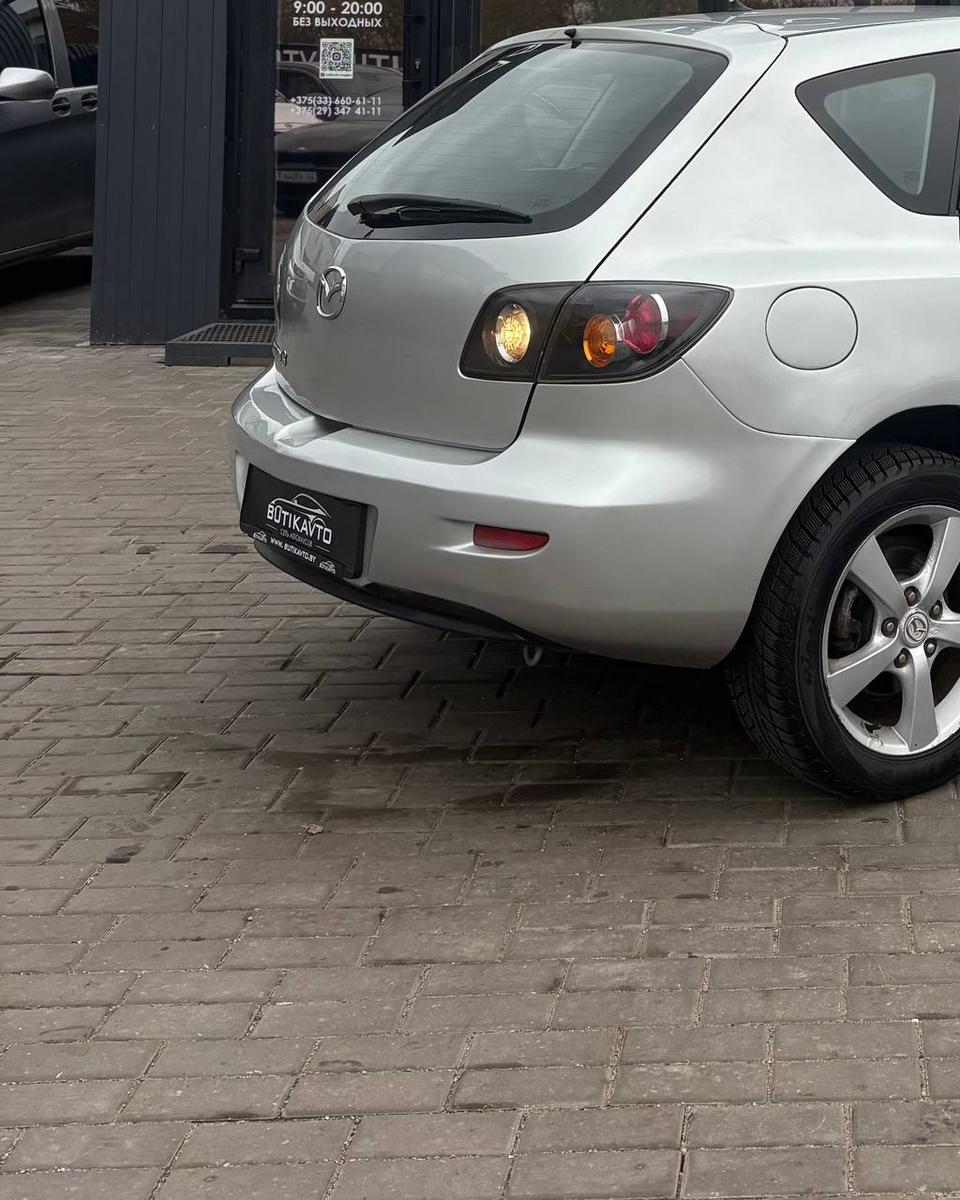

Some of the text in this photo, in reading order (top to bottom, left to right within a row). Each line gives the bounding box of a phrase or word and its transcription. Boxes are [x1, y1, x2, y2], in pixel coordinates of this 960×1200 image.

[293, 0, 326, 14] 9:00
[341, 1, 383, 15] 20:00
[292, 17, 382, 29] БЕЗ ВЫХОДНЫХ
[290, 96, 381, 107] +375(33) 660-61-11
[333, 106, 381, 116] 34741-11
[266, 504, 332, 545] BUTIKAVTO
